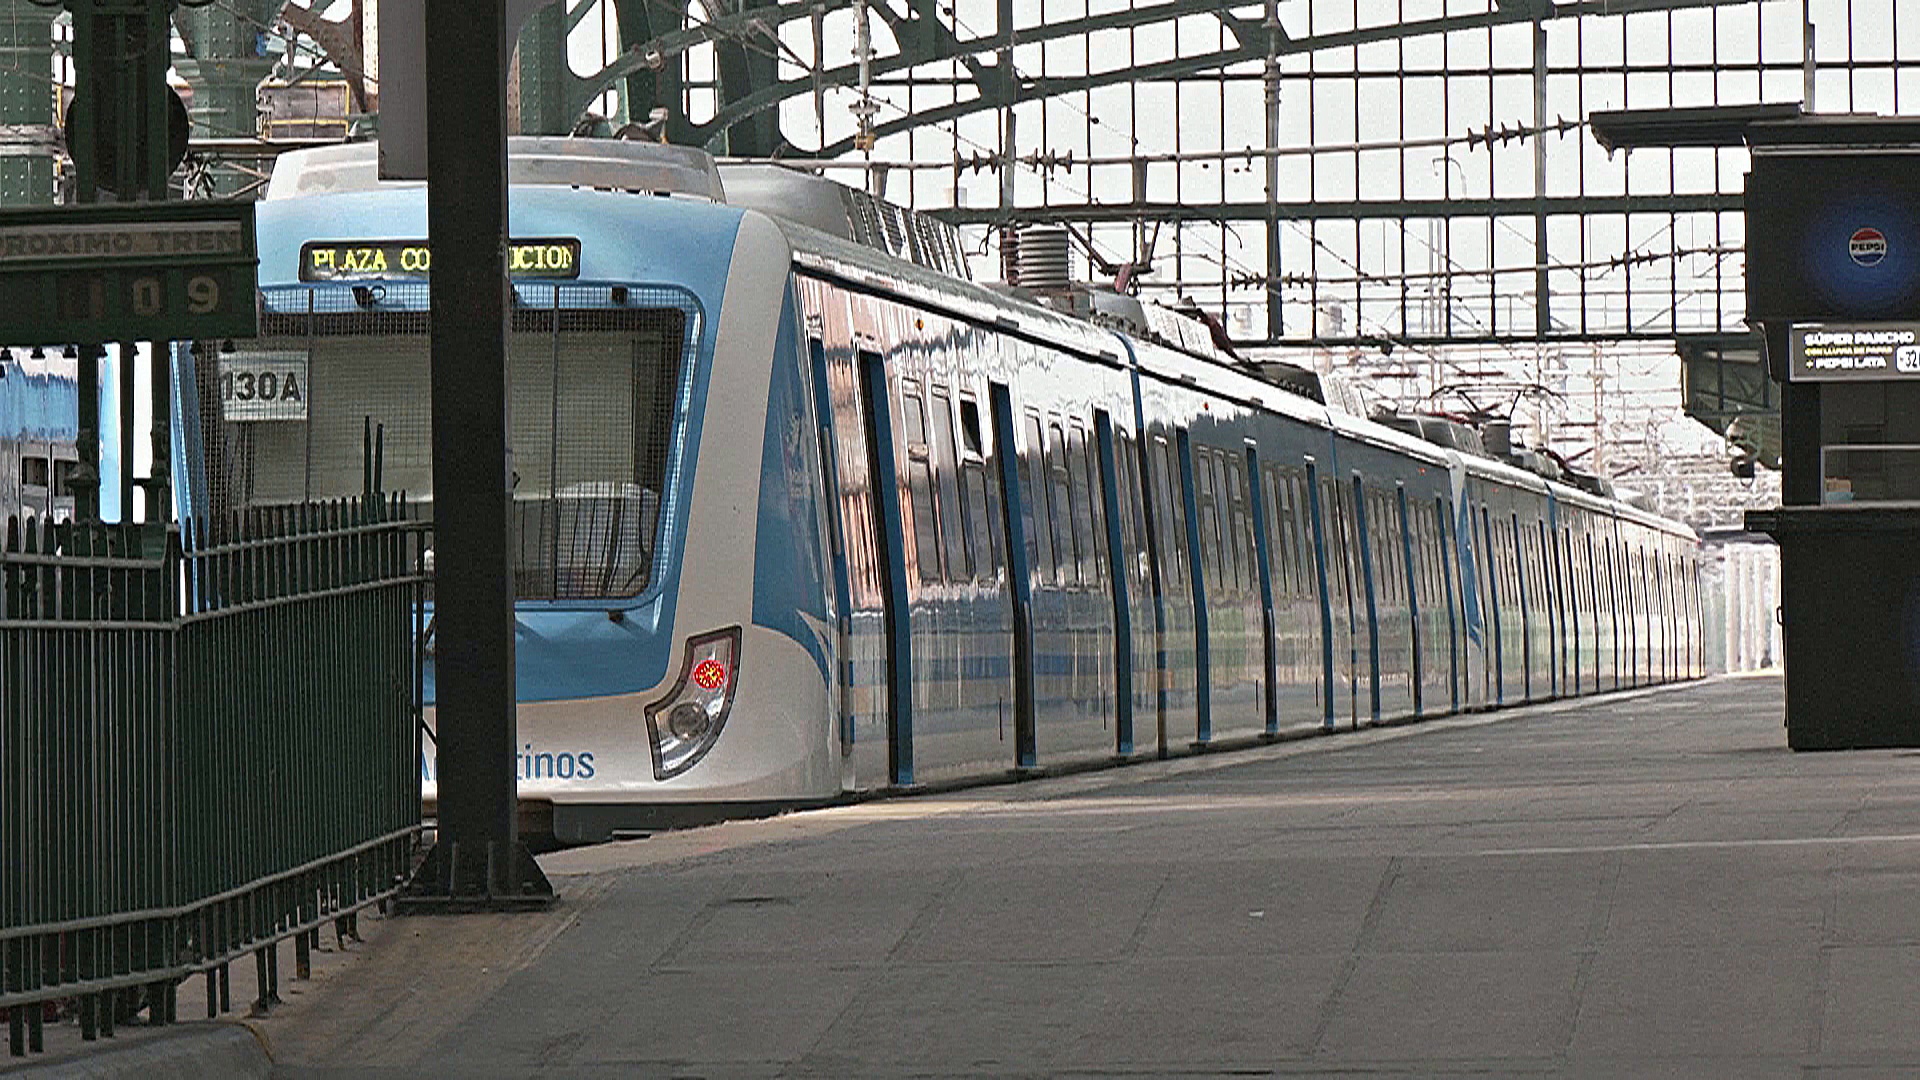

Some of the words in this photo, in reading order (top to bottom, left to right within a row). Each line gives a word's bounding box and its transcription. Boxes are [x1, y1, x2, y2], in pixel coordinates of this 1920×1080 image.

[0, 232, 132, 256] ROXIMO
[151, 231, 240, 253] TREN
[1851, 243, 1885, 251] PEPSI
[312, 249, 387, 272] PLAZA
[1854, 331, 1915, 344] PANCHO
[1815, 357, 1853, 369] PEPSI
[1854, 356, 1887, 368] LATA
[222, 371, 301, 401] 130A
